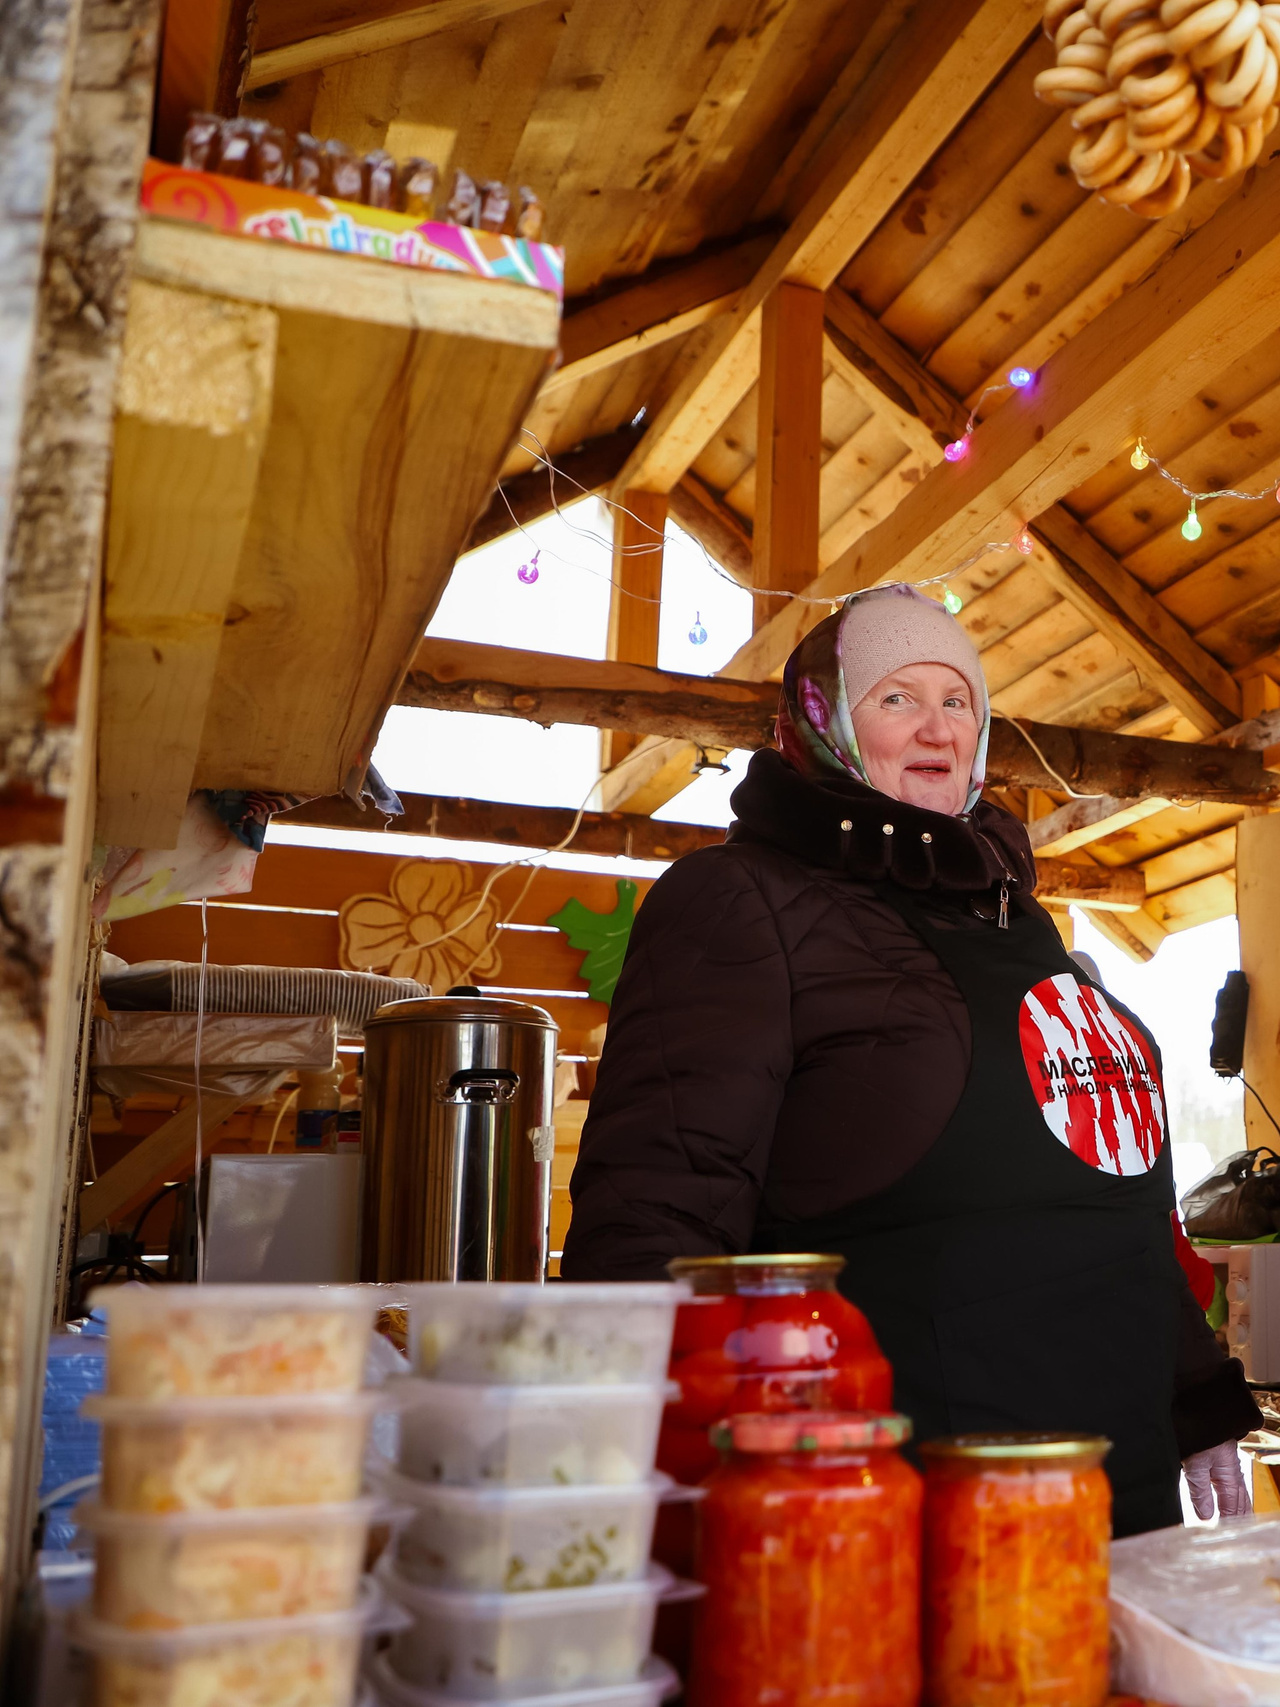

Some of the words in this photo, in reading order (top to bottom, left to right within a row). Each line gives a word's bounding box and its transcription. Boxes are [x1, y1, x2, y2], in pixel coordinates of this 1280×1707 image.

[1037, 1055, 1154, 1080] МАСЛЕНИЦА
[1045, 1086, 1055, 1100] В
[1059, 1081, 1158, 1098] НИКОЛА-ЛЕНИВЦЕ
